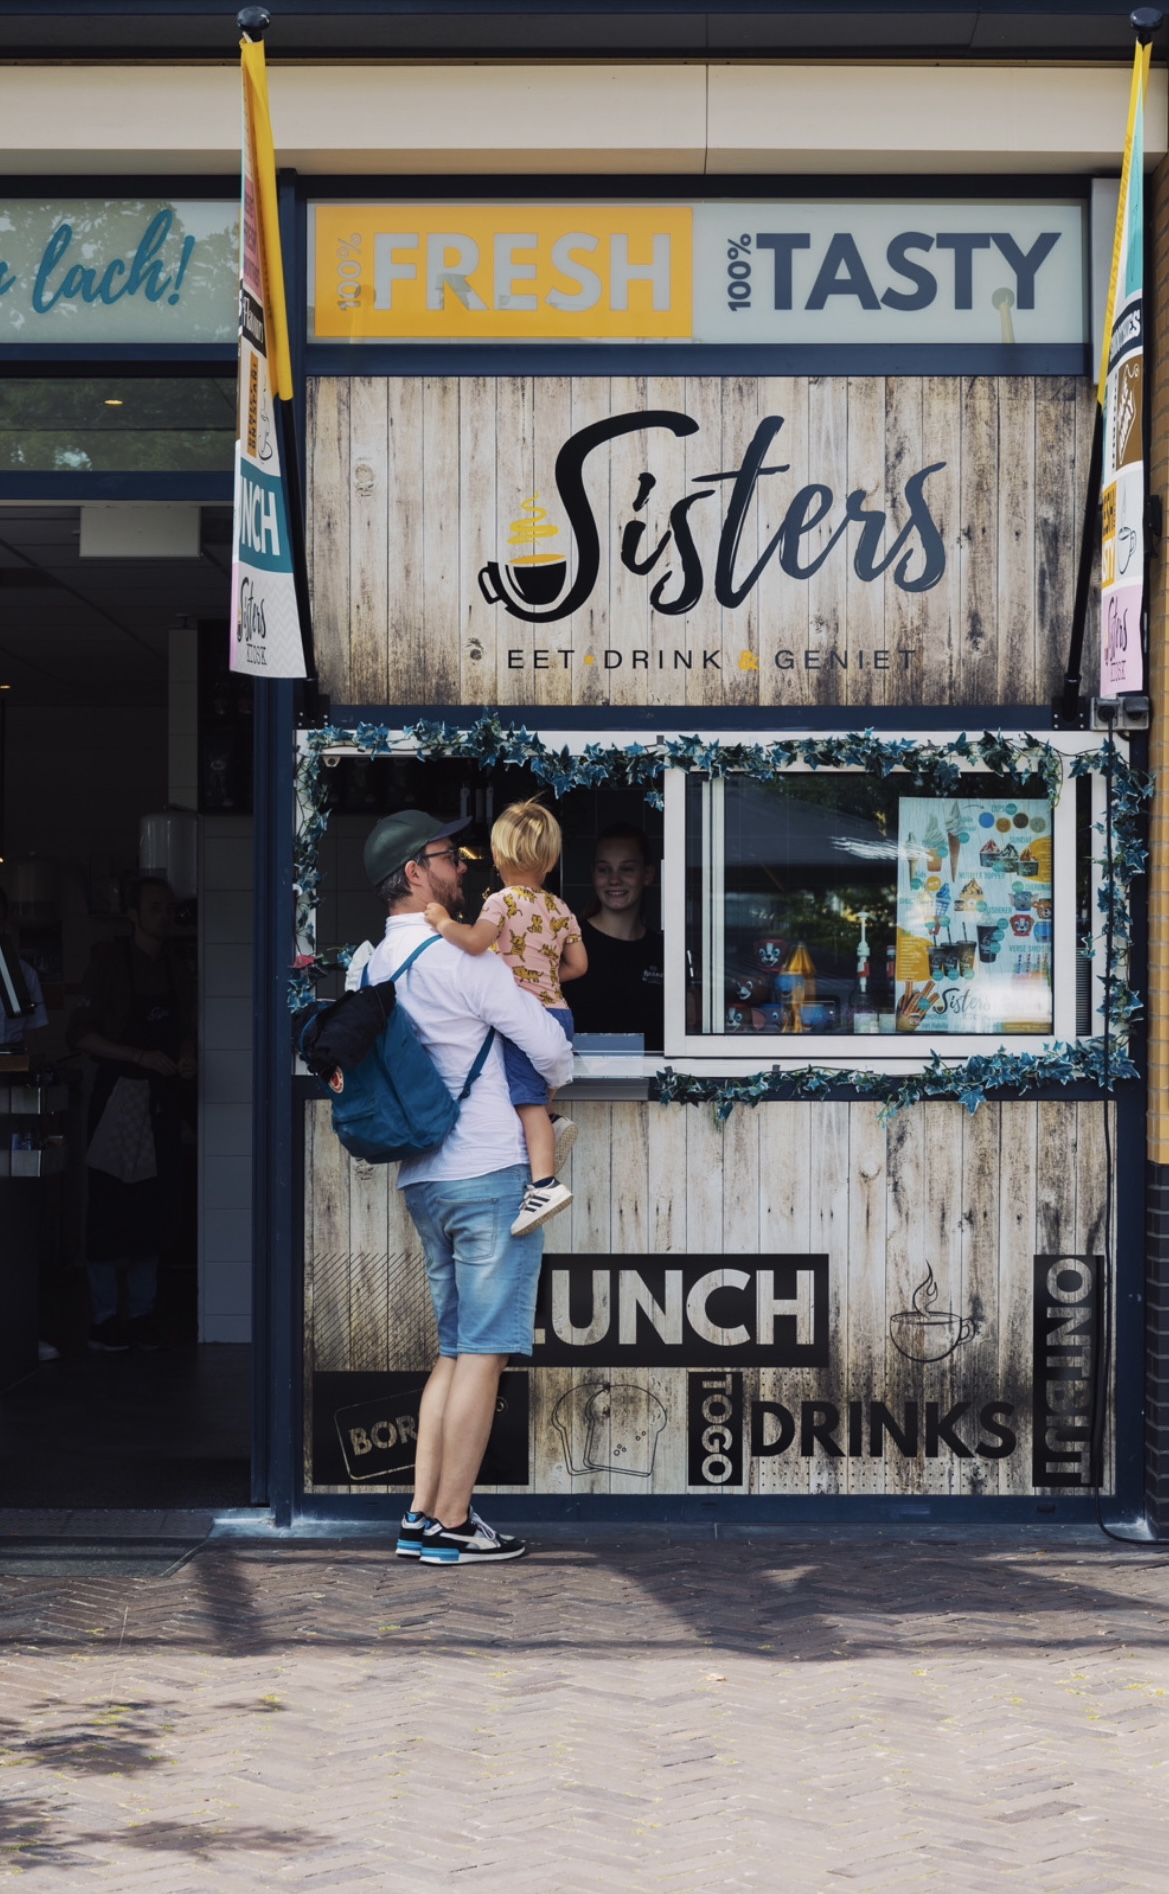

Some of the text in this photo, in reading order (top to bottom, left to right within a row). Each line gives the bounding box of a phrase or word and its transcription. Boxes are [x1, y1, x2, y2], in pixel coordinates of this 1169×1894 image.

[32, 209, 195, 313] lach!
[336, 232, 362, 311] 100%
[373, 230, 672, 312] FRESH
[727, 233, 752, 312] 100%
[756, 230, 1063, 312] TASTY
[504, 409, 947, 623] Sisters
[507, 649, 917, 671] EET DRINK & GENIET
[534, 1267, 815, 1347] UNCH
[1045, 1257, 1094, 1485] ONTBIJT
[348, 1414, 419, 1457] BOR
[750, 1400, 1018, 1459] DRINKS
